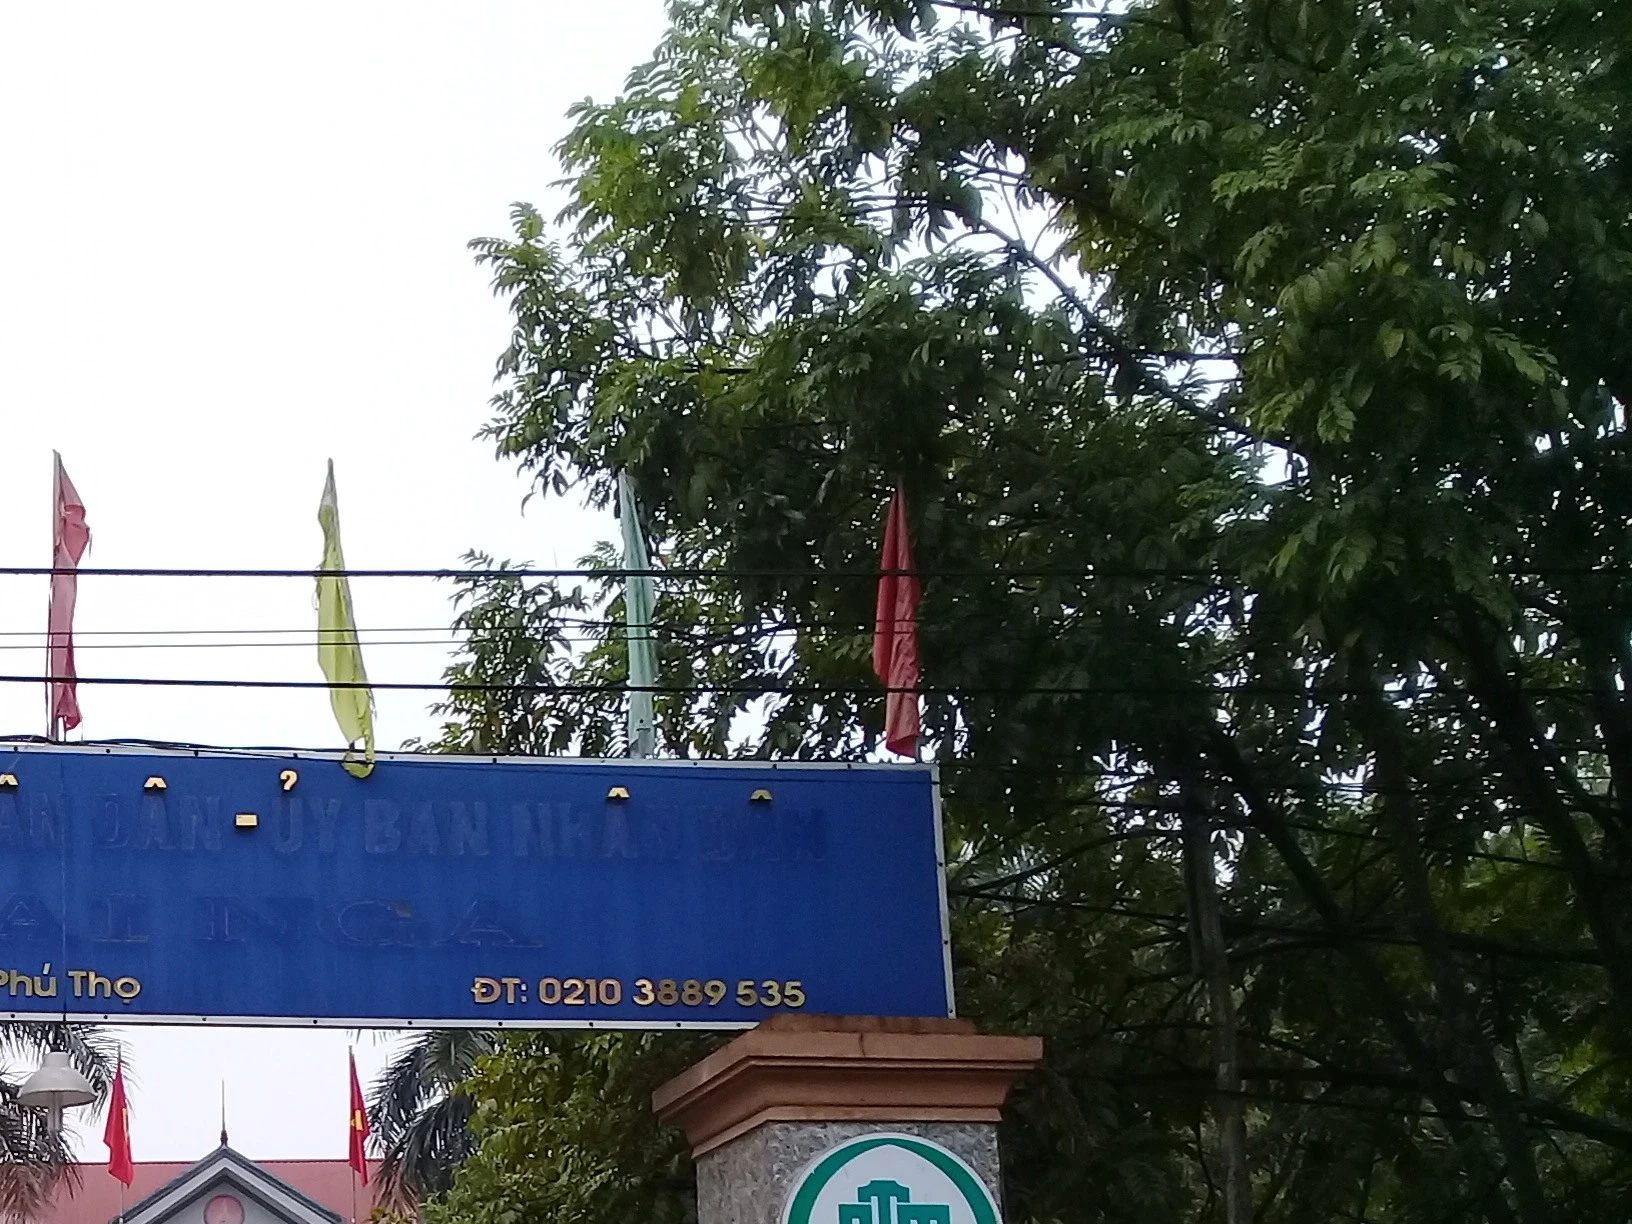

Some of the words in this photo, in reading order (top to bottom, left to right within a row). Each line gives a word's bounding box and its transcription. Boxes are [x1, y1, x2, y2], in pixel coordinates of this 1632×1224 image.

[67, 969, 142, 1005] Thọ
[470, 976, 529, 1005] ĐT:
[538, 977, 623, 1006] 0210
[632, 978, 727, 1007] 3889
[735, 979, 806, 1008] 535
